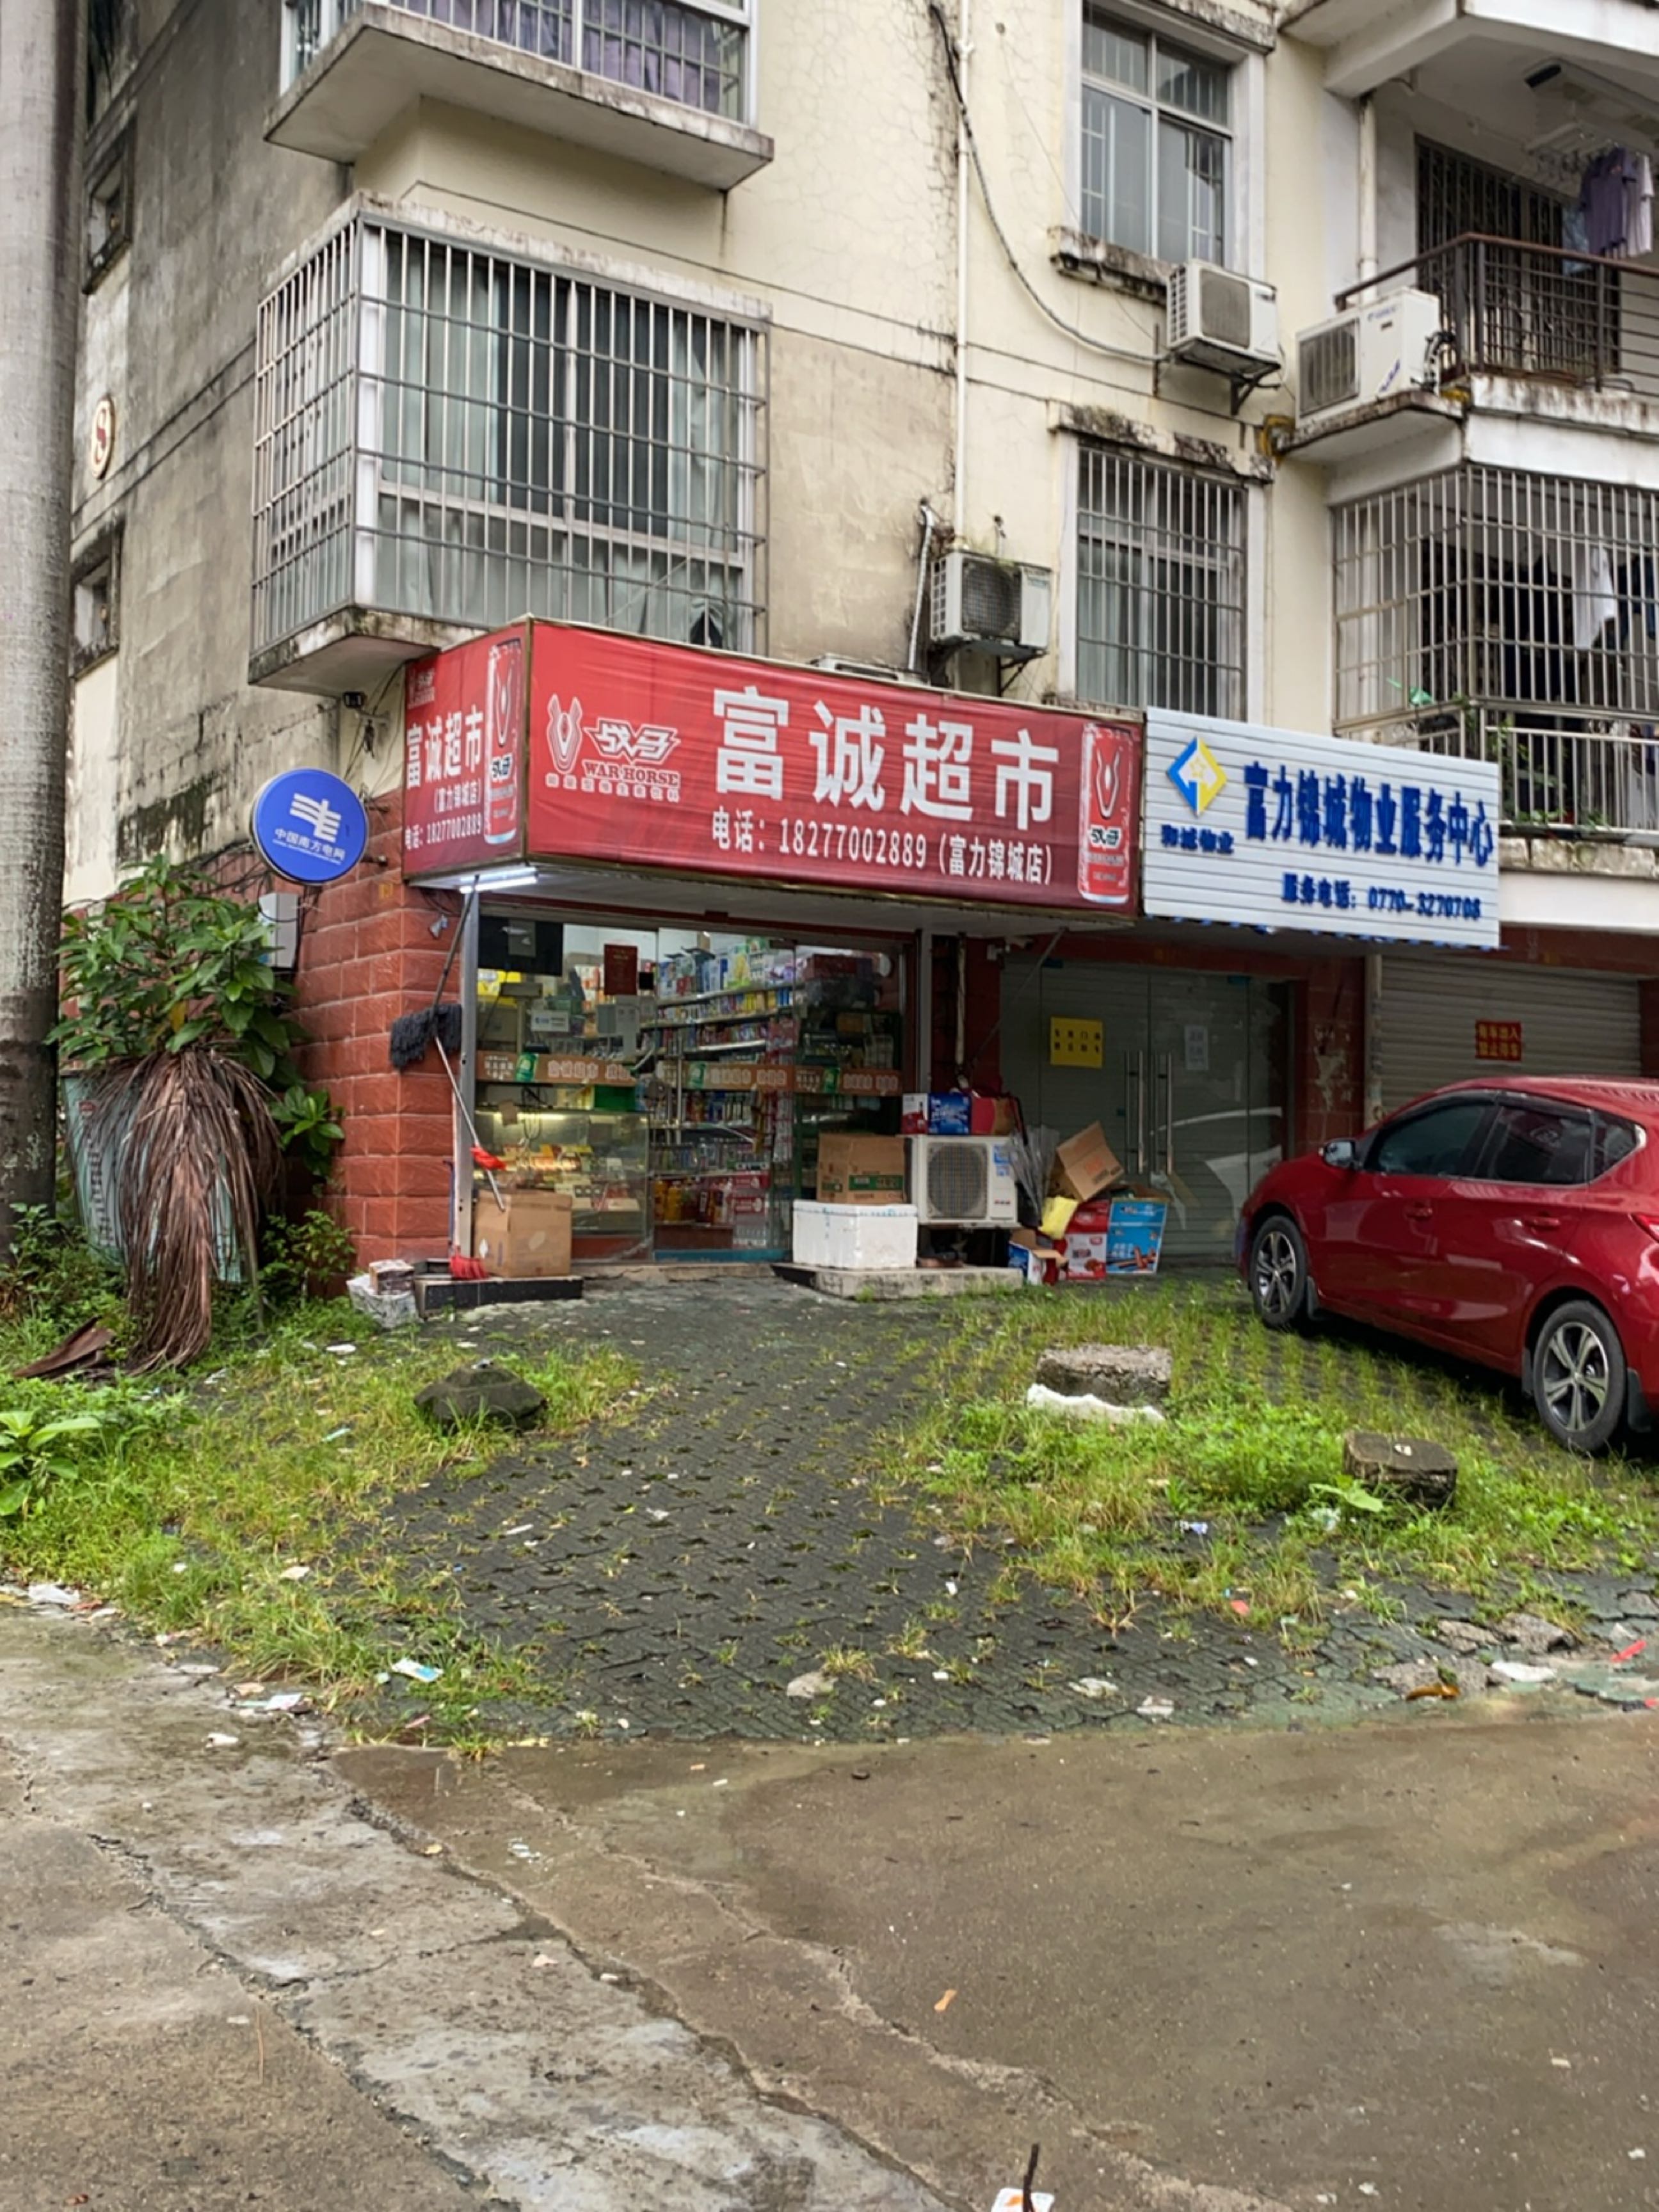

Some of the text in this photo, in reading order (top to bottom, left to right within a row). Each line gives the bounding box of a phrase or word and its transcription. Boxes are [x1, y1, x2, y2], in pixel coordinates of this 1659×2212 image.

[406, 704, 484, 790] 富诚超市
[584, 761, 680, 787] WAR HORSE
[714, 685, 1059, 831] 富诚超市
[275, 828, 346, 861] 中国南方电网
[1244, 760, 1495, 868] 富力锦城物业服务中心
